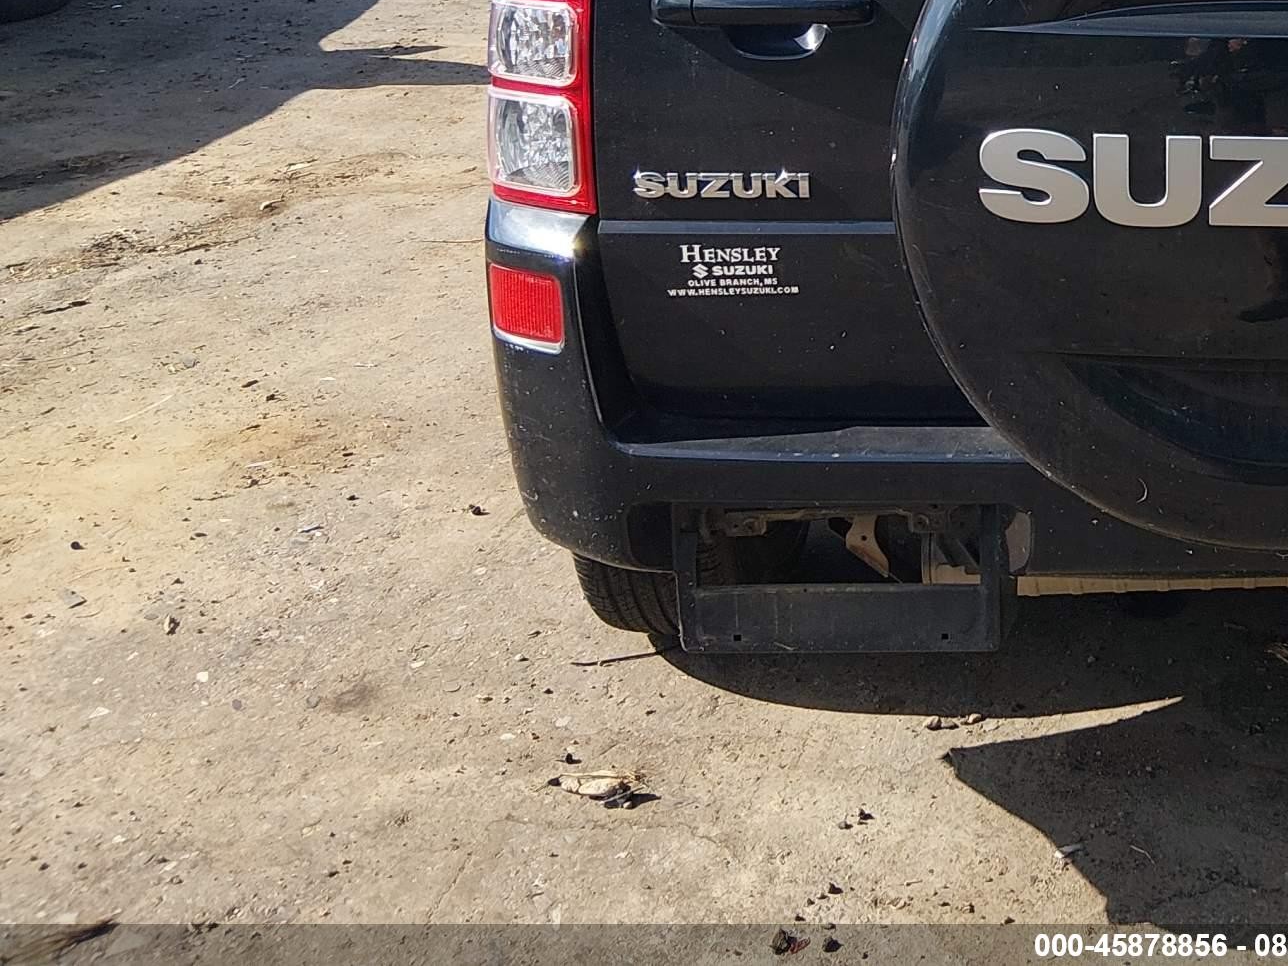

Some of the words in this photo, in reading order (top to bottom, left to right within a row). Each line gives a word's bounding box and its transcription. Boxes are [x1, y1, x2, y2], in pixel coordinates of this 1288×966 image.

[633, 171, 811, 199] SUZUKI
[711, 265, 774, 276] SUZUKI
[687, 278, 717, 287] OLIVE
